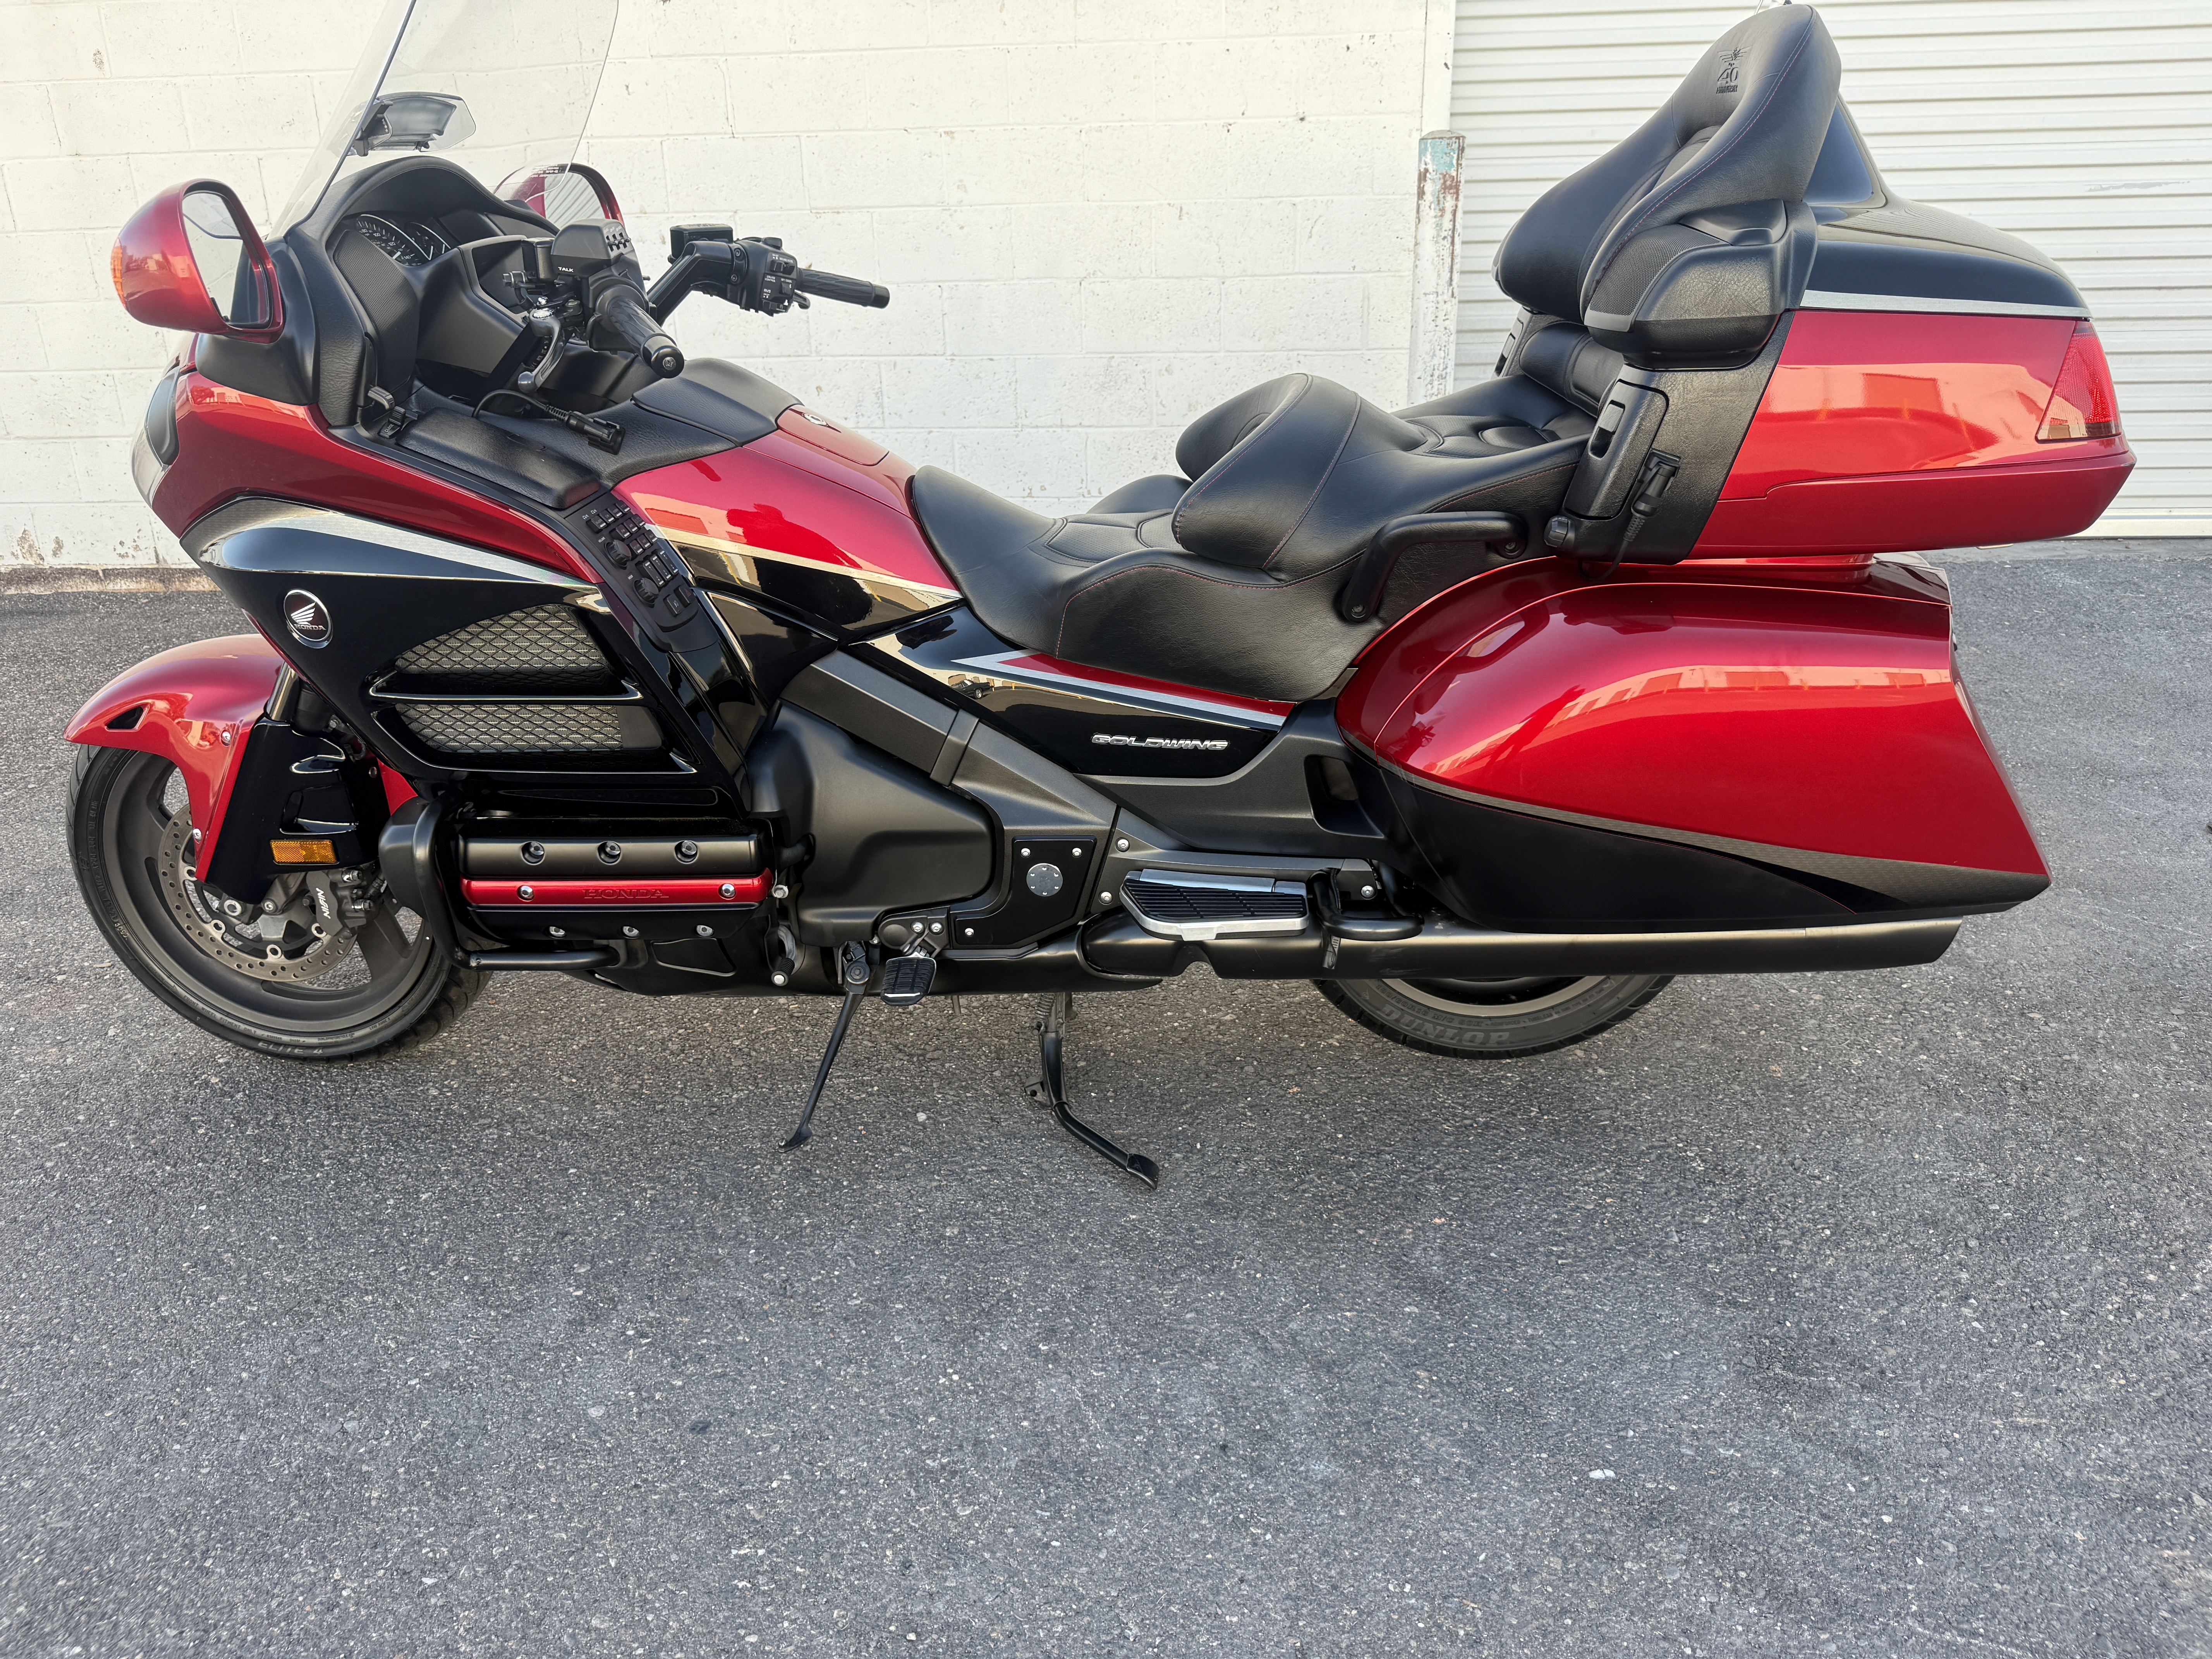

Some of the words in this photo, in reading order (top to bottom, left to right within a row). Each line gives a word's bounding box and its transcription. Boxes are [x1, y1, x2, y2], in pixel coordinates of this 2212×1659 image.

[1091, 733, 1230, 750] GOLDWING
[316, 888, 331, 919] NISSIN
[582, 888, 669, 899] HONDA
[183, 995, 199, 1008] FRONT
[201, 1006, 217, 1018] WHEEL
[220, 1017, 241, 1029] FITMENT
[1376, 1003, 1510, 1046] DUNLOP
[258, 1041, 304, 1054] ELITE
[313, 1047, 323, 1055] 4
